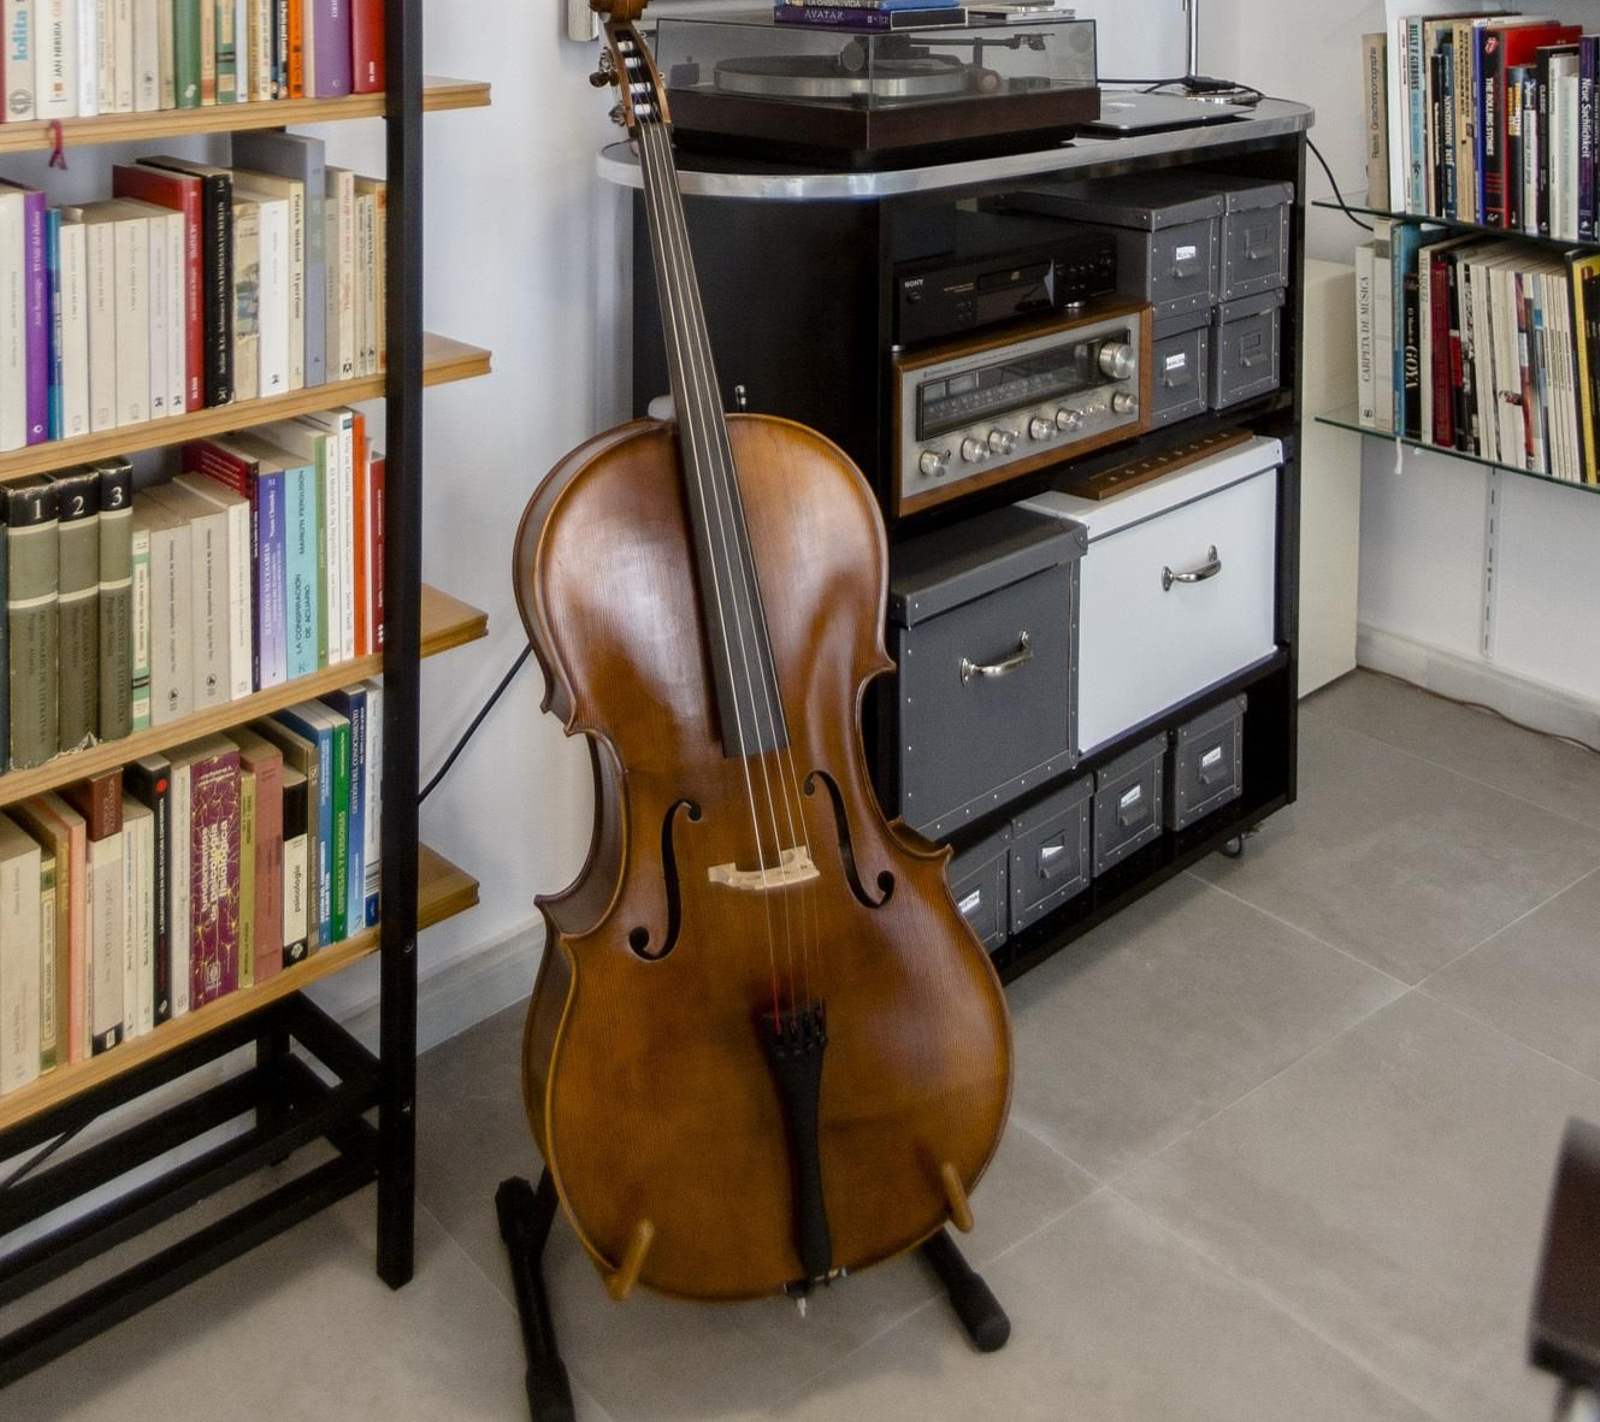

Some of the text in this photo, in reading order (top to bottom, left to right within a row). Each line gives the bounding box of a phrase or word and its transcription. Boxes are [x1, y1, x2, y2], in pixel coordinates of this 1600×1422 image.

[804, 10, 844, 20] AVATAR
[12, 10, 28, 61] lolita
[54, 21, 62, 76] JAN NERUDA
[1410, 24, 1419, 46] BILLY
[1410, 56, 1419, 90] GIBBONS
[1486, 77, 1494, 156] THE ROLLING STONES
[1582, 78, 1591, 158] Neue Sachlichkeit
[904, 279, 924, 288] SONY
[1359, 276, 1370, 382] CARPETA DE MÚSICA
[1405, 346, 1418, 389] GOYA
[34, 498, 43, 520] 1
[72, 496, 85, 516] 2
[110, 486, 123, 506] 3
[38, 610, 46, 669] DICCIONARIO
[295, 642, 302, 655] LA
[304, 627, 311, 639] DE
[38, 686, 46, 744] LITERATURA
[200, 827, 208, 912] fundamentos
[210, 904, 218, 922] de
